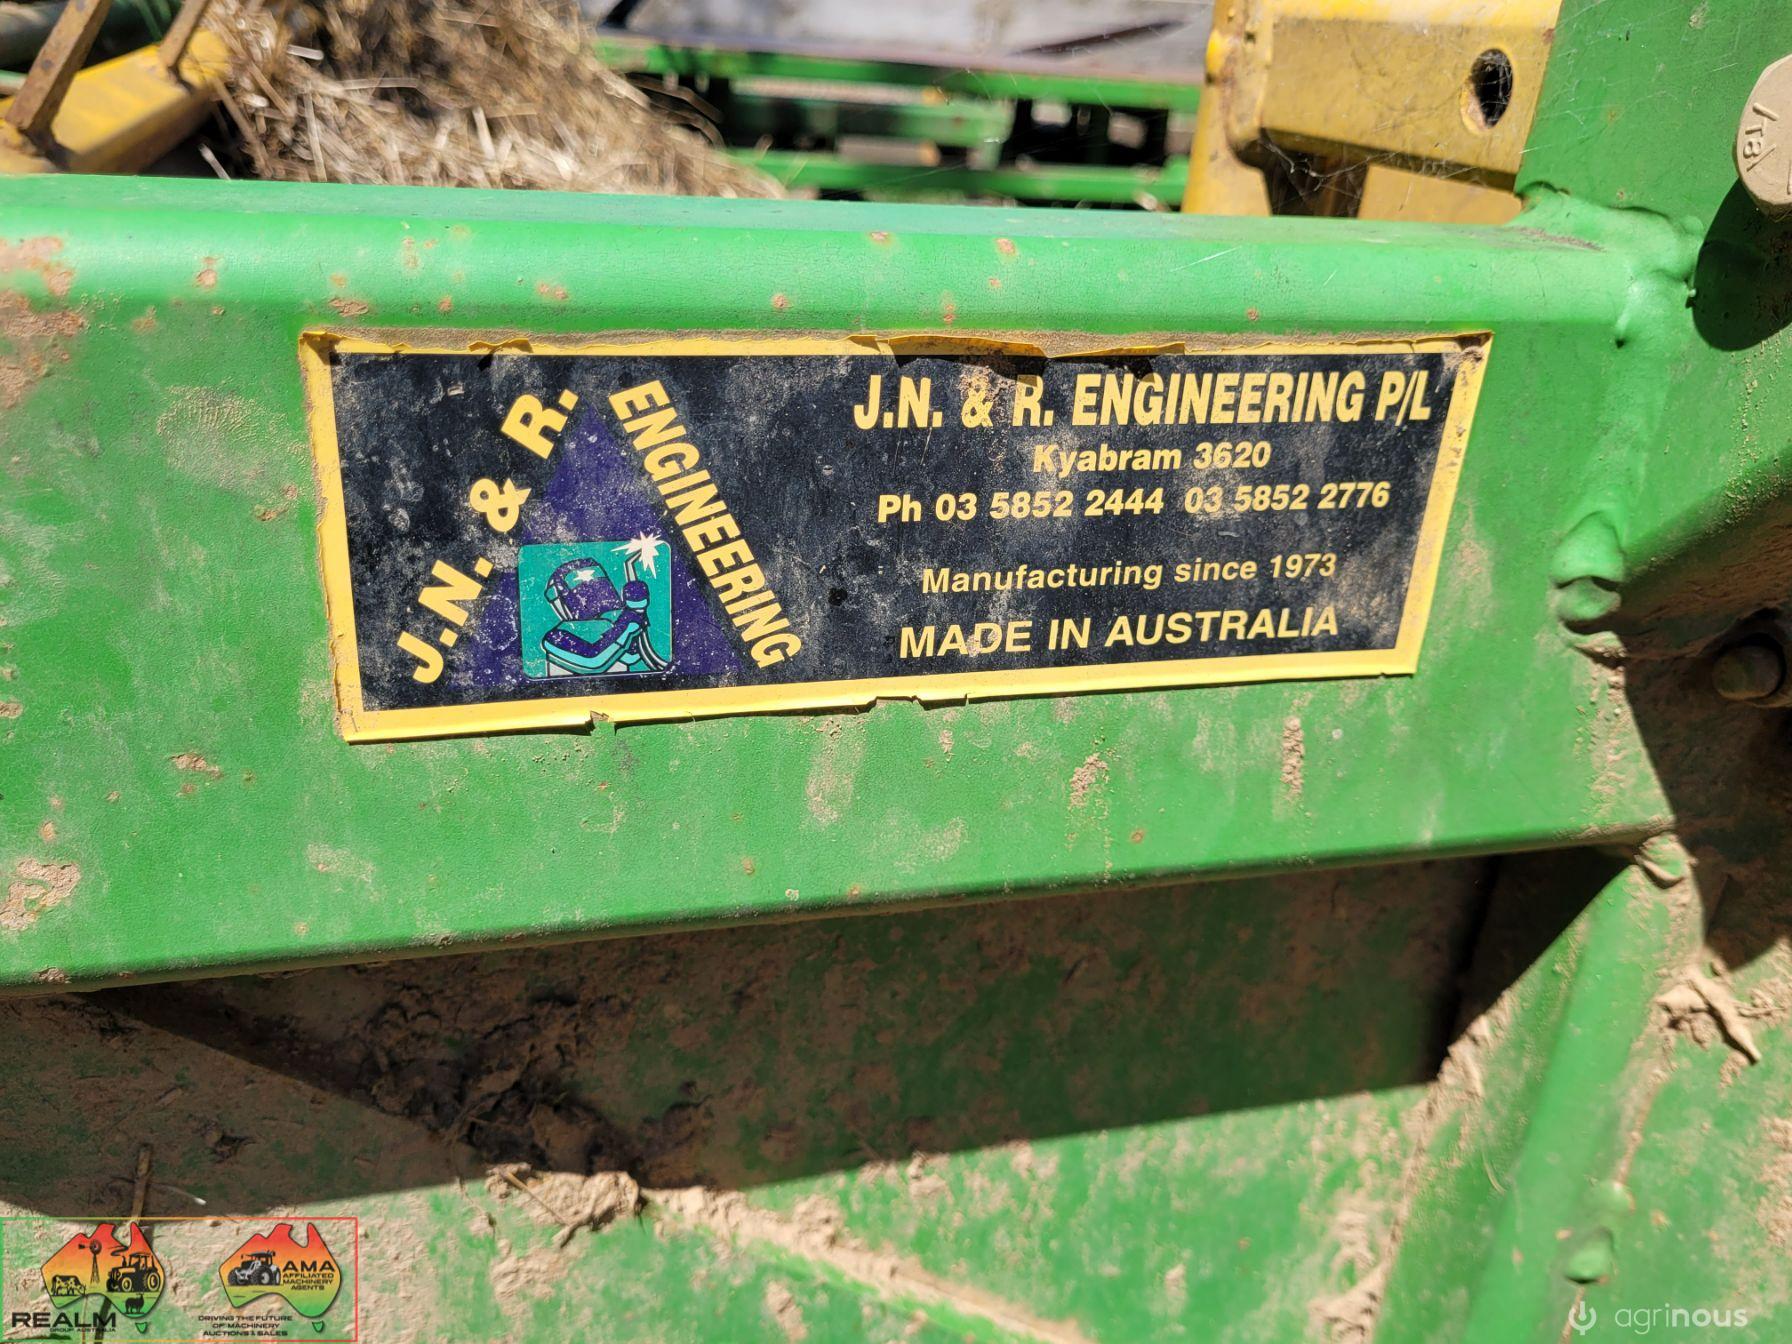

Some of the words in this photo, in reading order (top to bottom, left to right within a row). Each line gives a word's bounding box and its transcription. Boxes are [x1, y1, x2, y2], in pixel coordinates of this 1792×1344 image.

[853, 374, 943, 430] J.N.
[961, 382, 994, 428] &
[1012, 374, 1055, 427] R.
[1071, 371, 1366, 426] ENGINEERING
[1374, 370, 1431, 427] P/L
[1033, 443, 1182, 478] Kyabram
[1193, 440, 1272, 470] 3620
[608, 379, 802, 669] ENGINEERING
[877, 494, 922, 523] Ph
[935, 493, 978, 521] 03
[989, 490, 1074, 520] 5852
[1084, 487, 1165, 517] 2444
[1184, 486, 1224, 514] 03
[1234, 483, 1311, 513] 5852
[1317, 481, 1392, 509] 2776
[397, 557, 494, 684] J.N.
[470, 477, 532, 533] &
[501, 388, 579, 459] R.
[922, 560, 1164, 594] Manufacturing
[1174, 557, 1258, 583] since
[1269, 552, 1338, 579] 1973
[899, 620, 1034, 659] MADE
[1048, 617, 1092, 650] IN
[1104, 605, 1338, 648] AUSTRALIA
